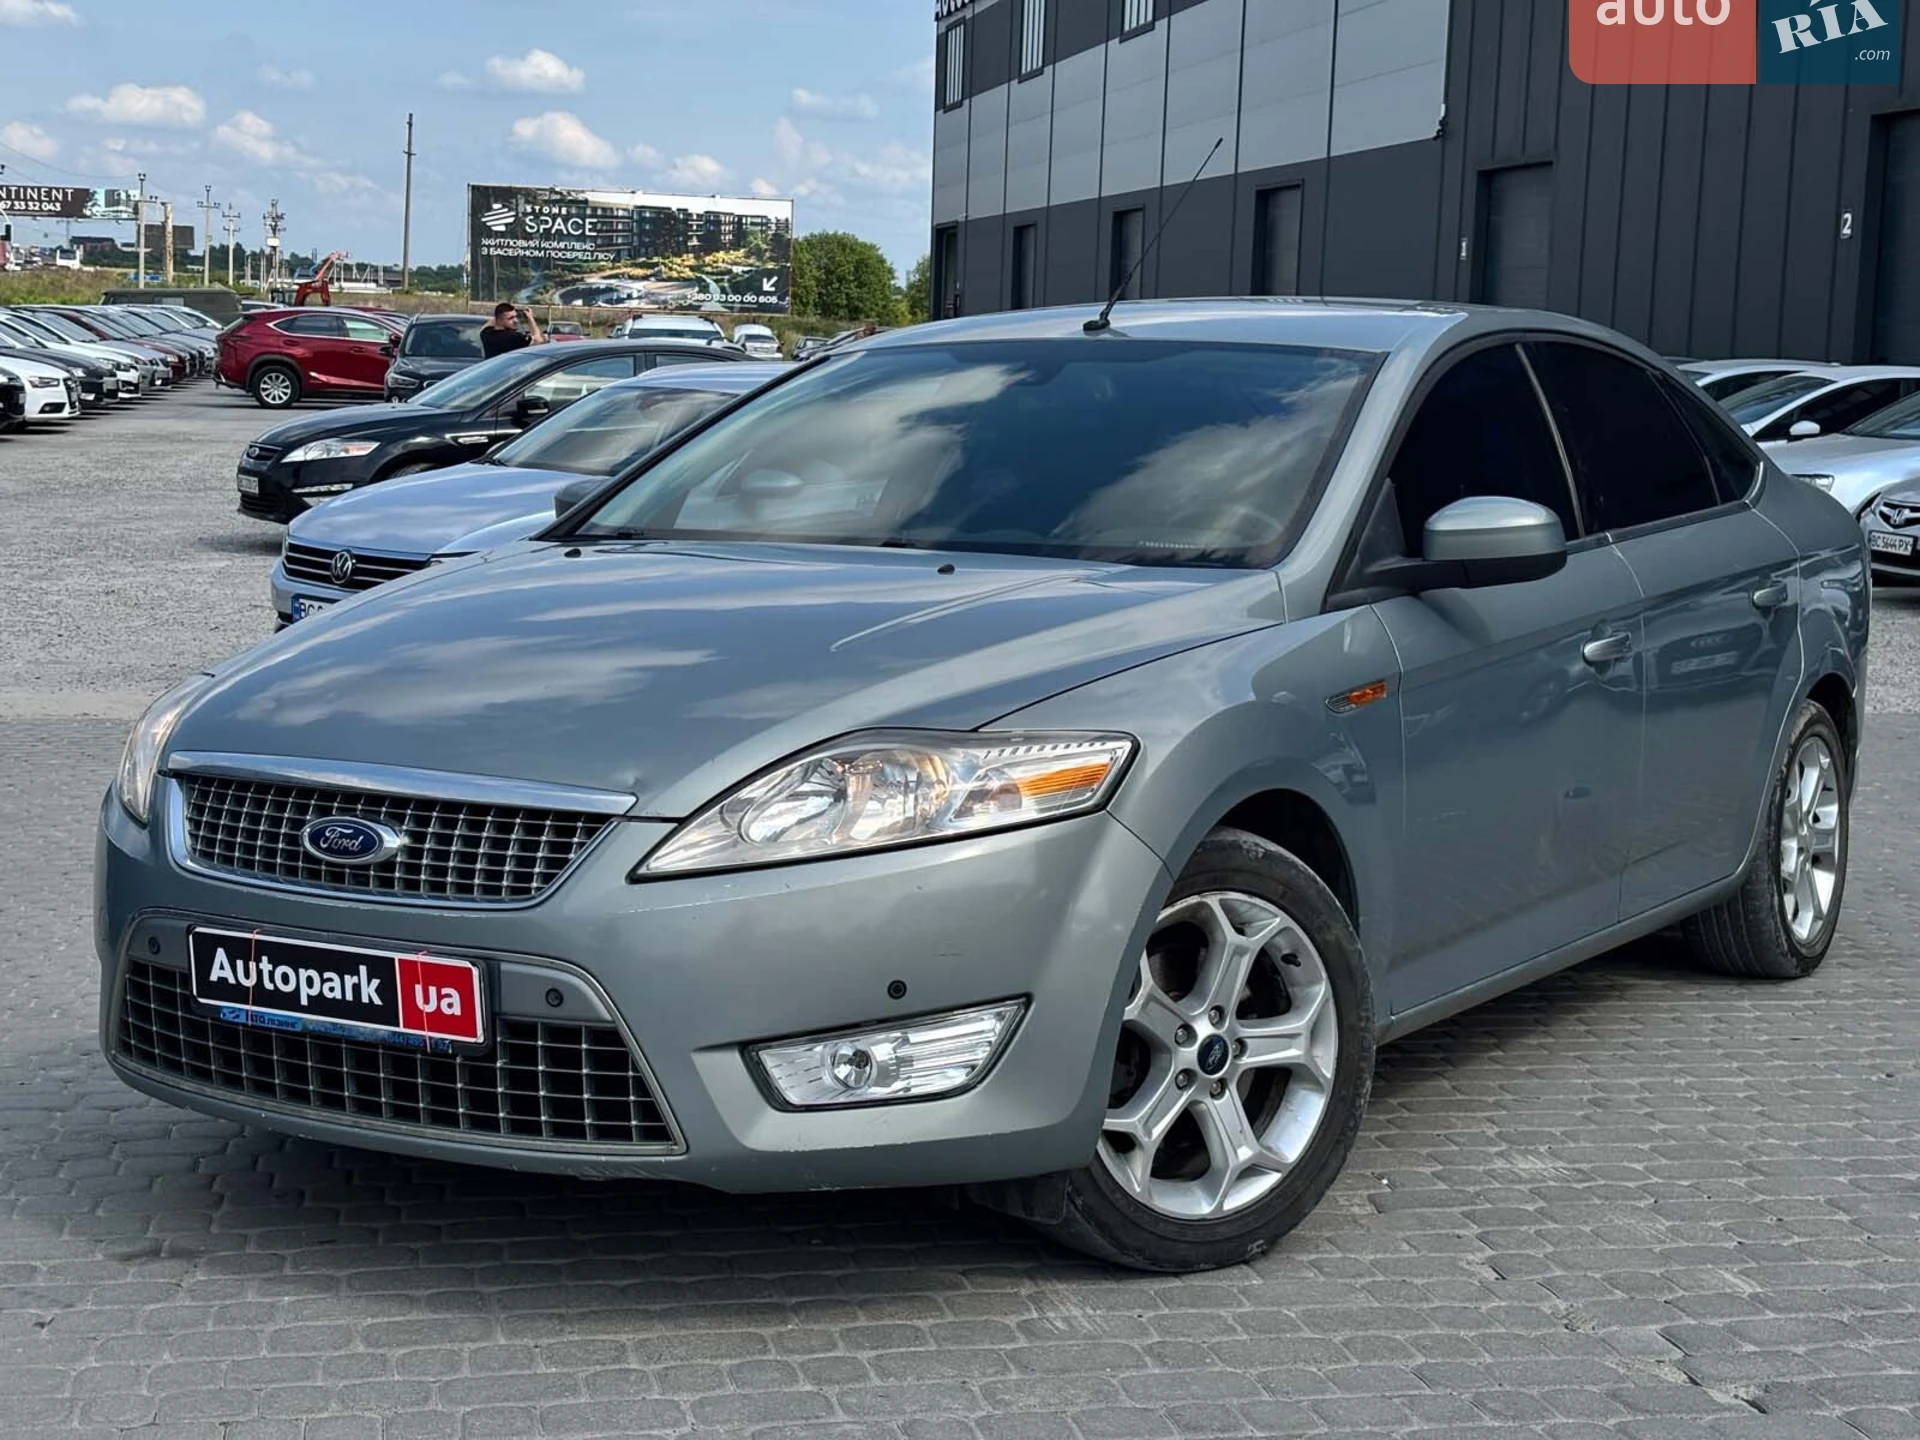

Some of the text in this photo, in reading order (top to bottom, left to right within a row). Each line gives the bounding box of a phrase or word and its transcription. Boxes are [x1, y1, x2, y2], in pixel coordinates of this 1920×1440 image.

[526, 205, 567, 214] STONE
[525, 215, 597, 236] SPACE
[1842, 212, 1852, 234] 2
[541, 240, 595, 250] КОМПЛЕКС
[320, 826, 364, 852] Ford
[209, 947, 462, 1016] Autopark ua
